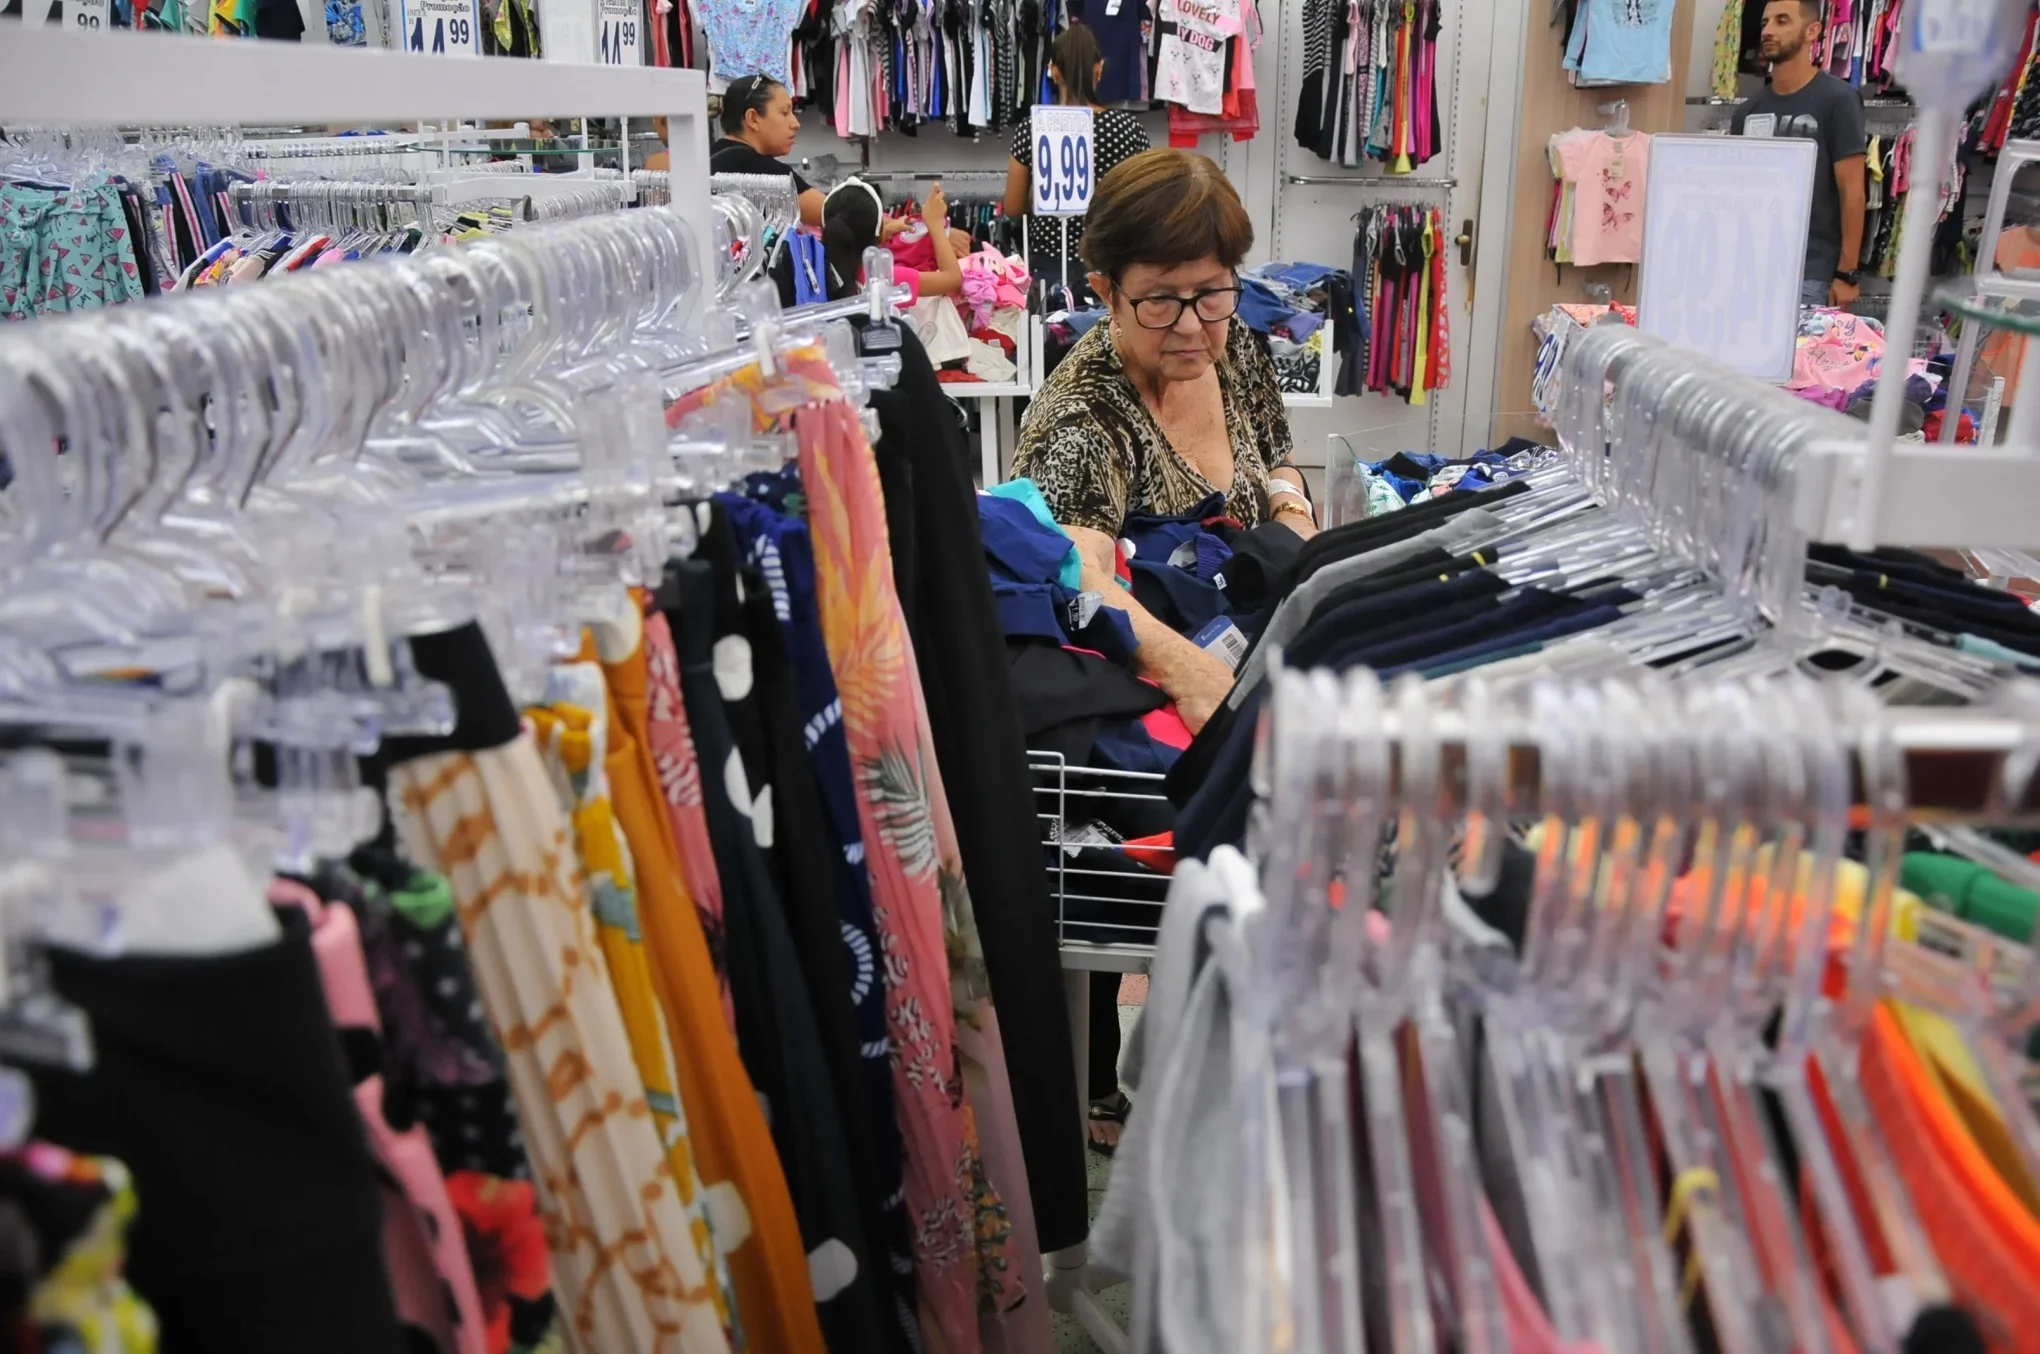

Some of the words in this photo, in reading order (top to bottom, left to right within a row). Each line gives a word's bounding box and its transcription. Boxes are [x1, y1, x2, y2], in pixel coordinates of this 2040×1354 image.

[1177, 0, 1219, 25] LOVELY
[1189, 29, 1214, 52] DOG
[1047, 112, 1088, 132] PARTIR
[1038, 134, 1089, 212] 9,99
